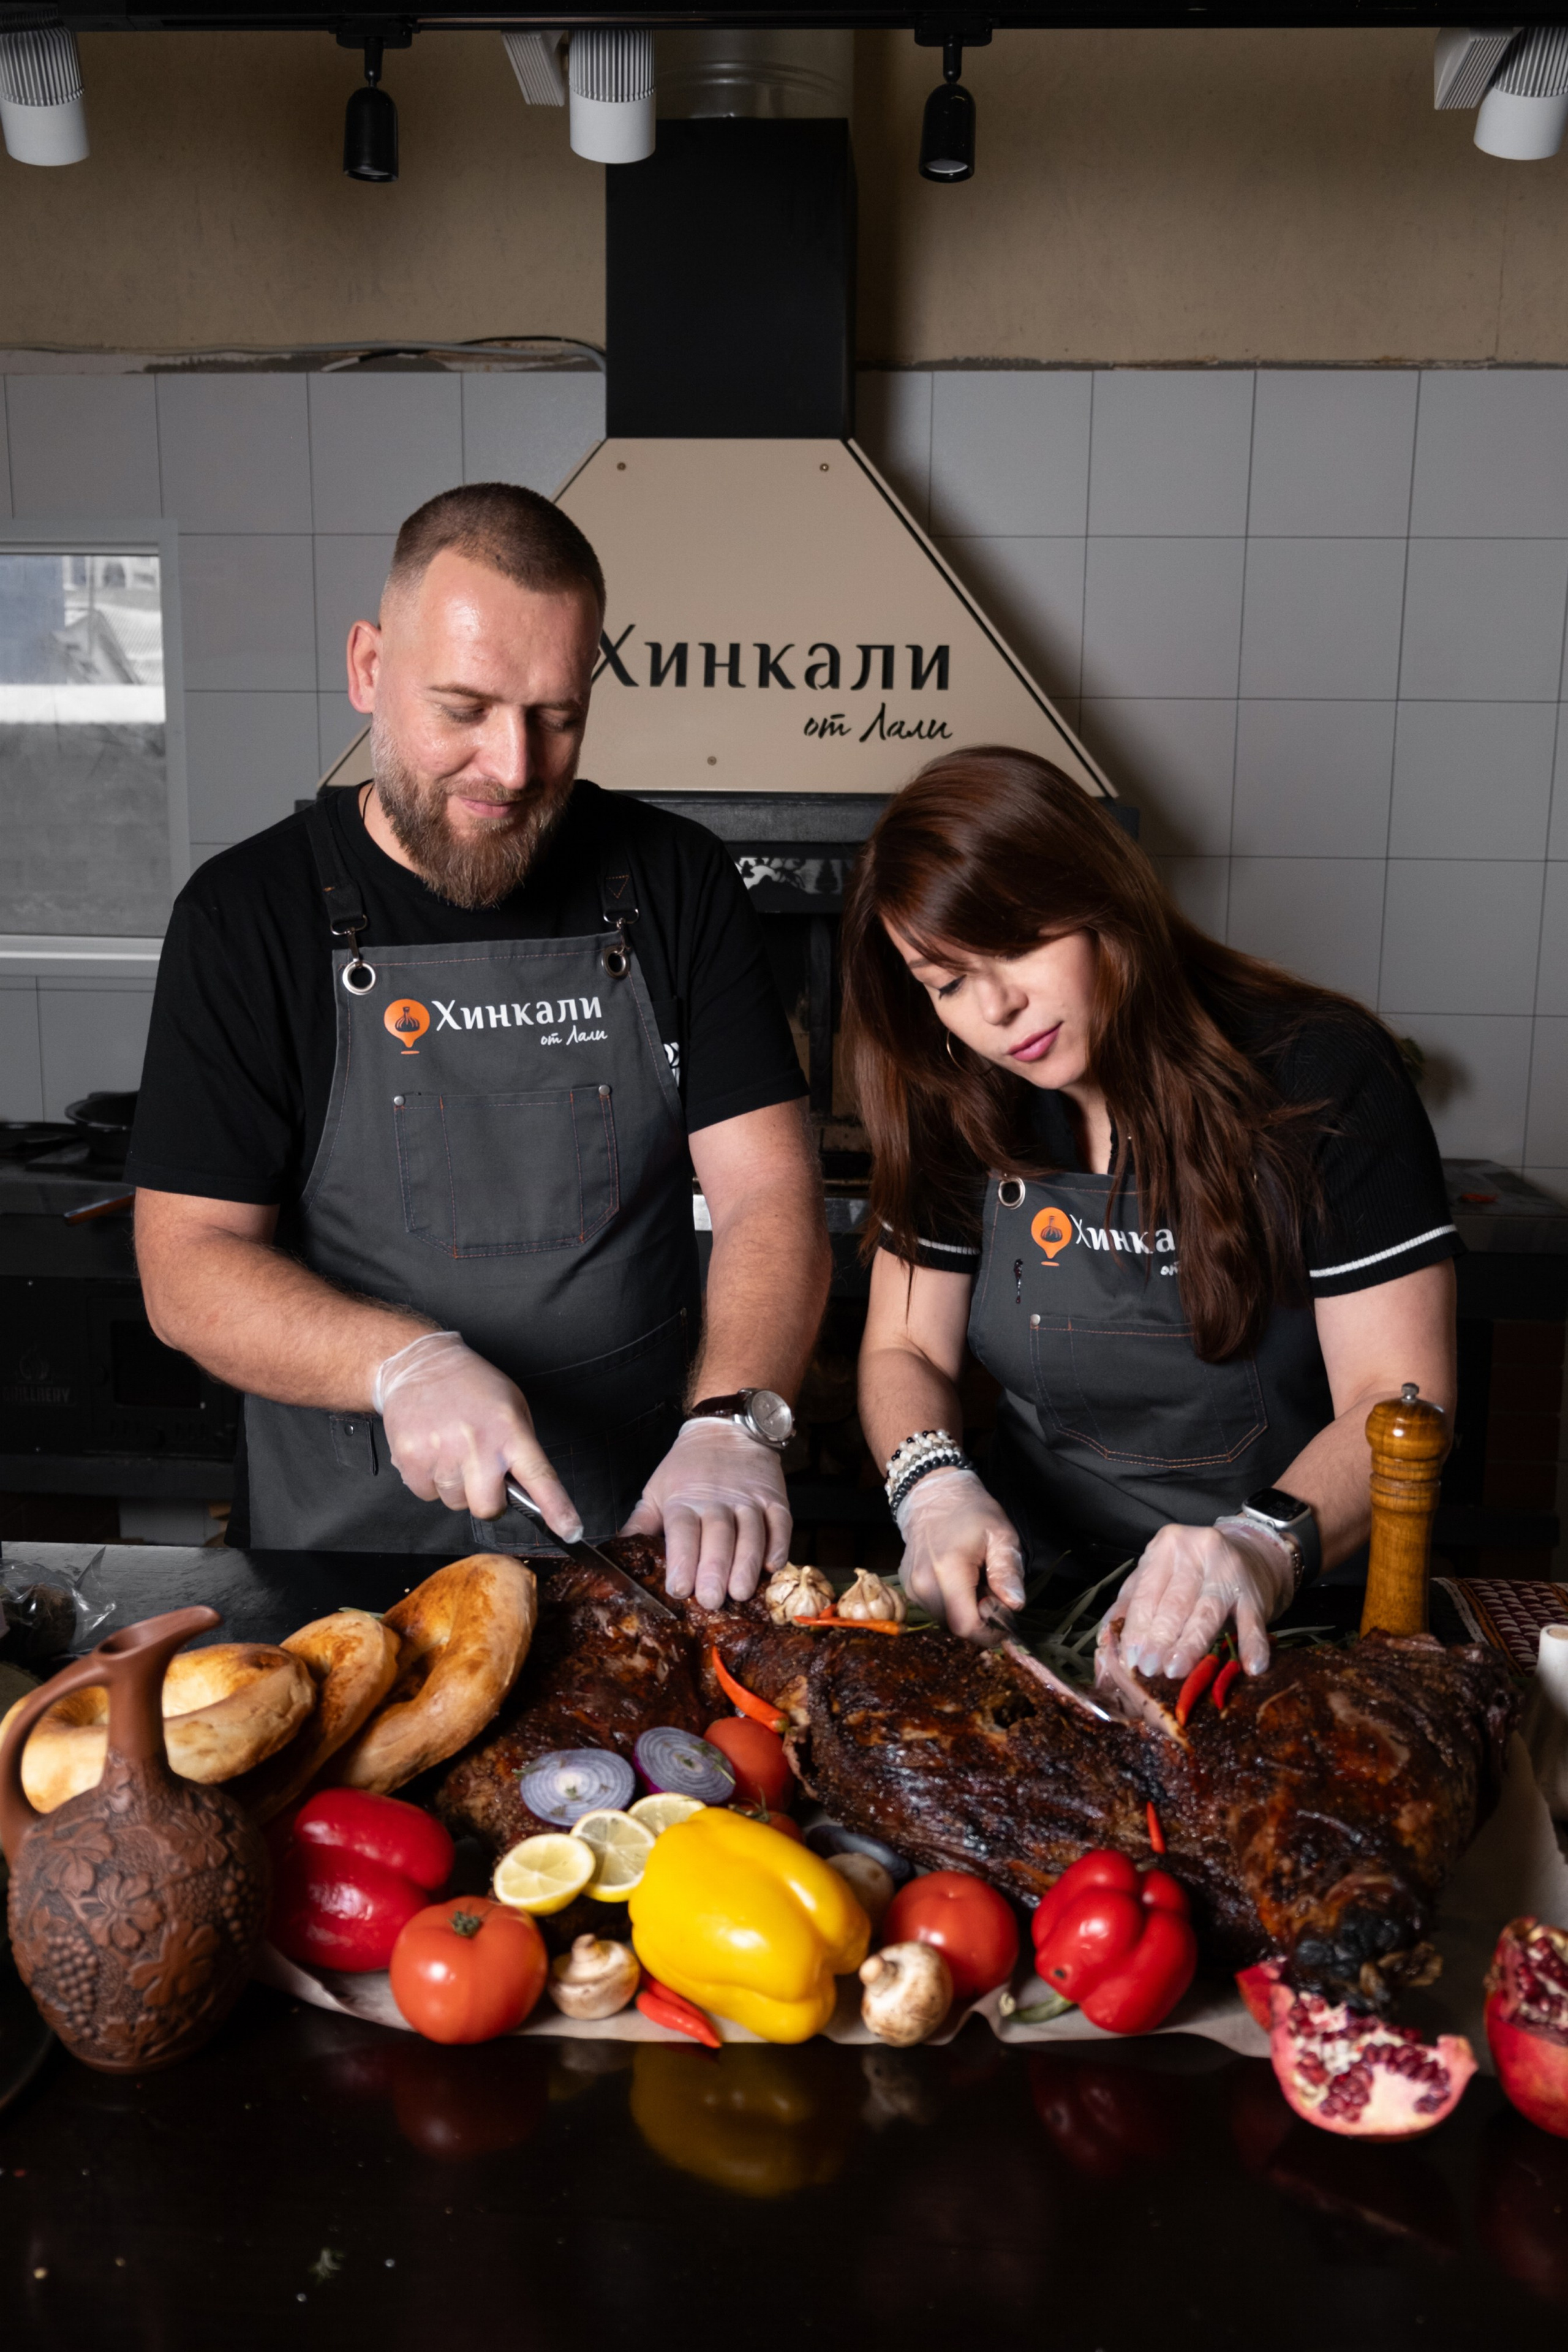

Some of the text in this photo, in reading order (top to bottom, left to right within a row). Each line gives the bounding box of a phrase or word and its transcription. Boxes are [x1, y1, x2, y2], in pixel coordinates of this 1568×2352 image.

[591, 624, 950, 691] Хинкали
[804, 702, 952, 742] от Лали
[431, 996, 602, 1031] Хинкали
[540, 1025, 608, 1046] от Лали
[1069, 1214, 1175, 1254] Хинка
